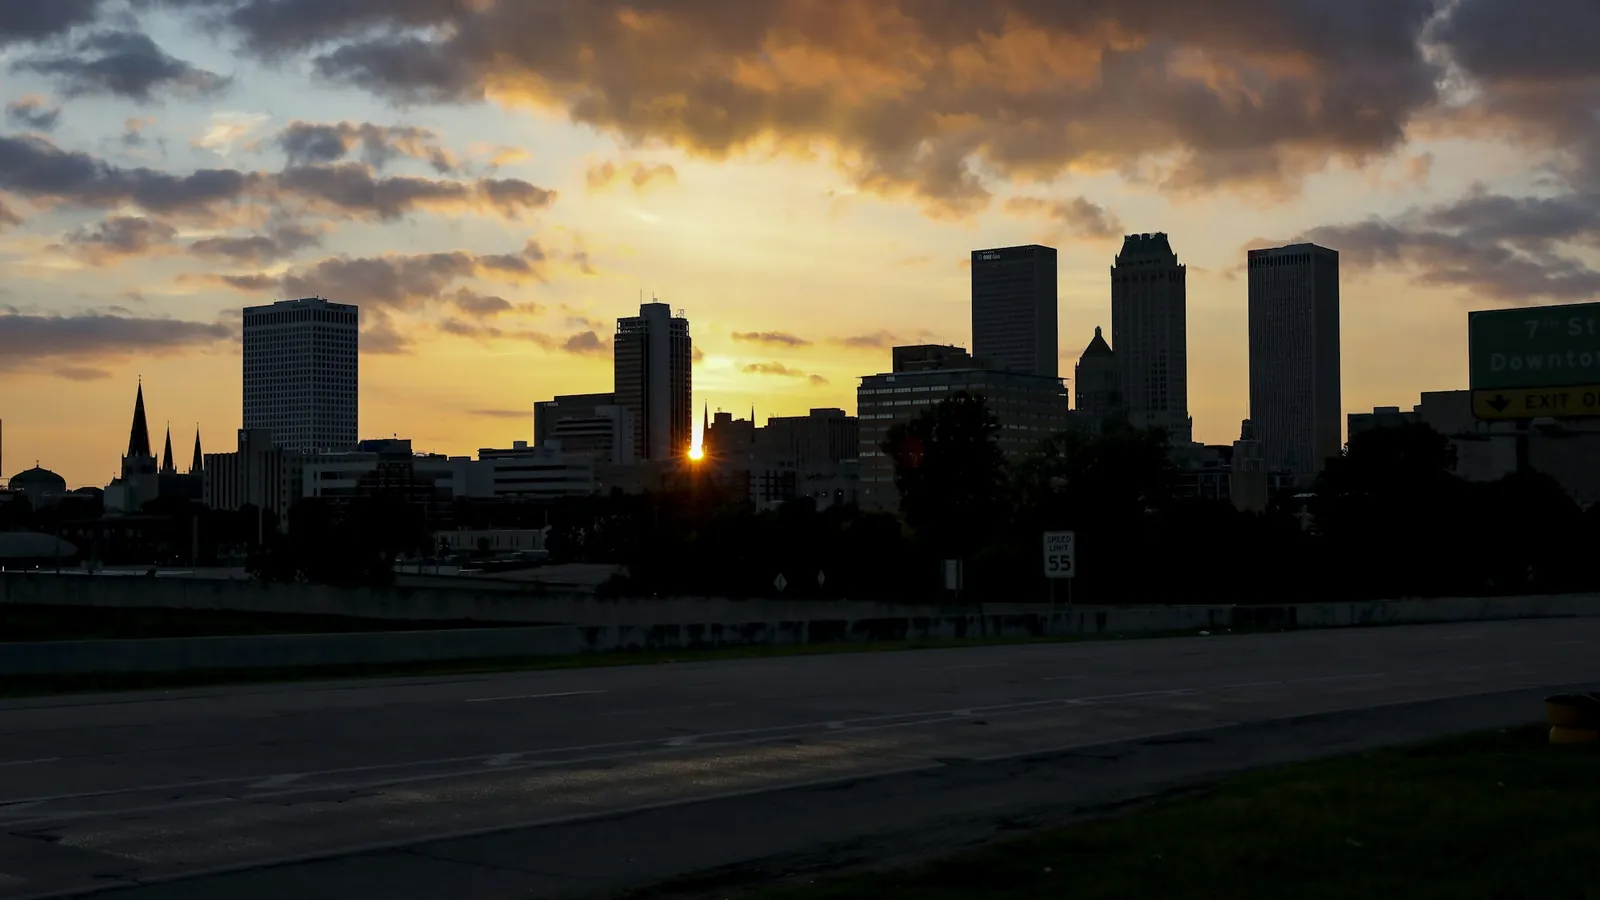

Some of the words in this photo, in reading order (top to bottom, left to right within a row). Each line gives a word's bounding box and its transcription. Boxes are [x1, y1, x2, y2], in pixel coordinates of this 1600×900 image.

[1567, 315, 1597, 336] St
[1526, 393, 1570, 409] EXIT
[1583, 391, 1600, 407] O
[1046, 535, 1072, 543] SPEED
[1049, 544, 1068, 552] LIMIT
[1049, 555, 1071, 571] 55
